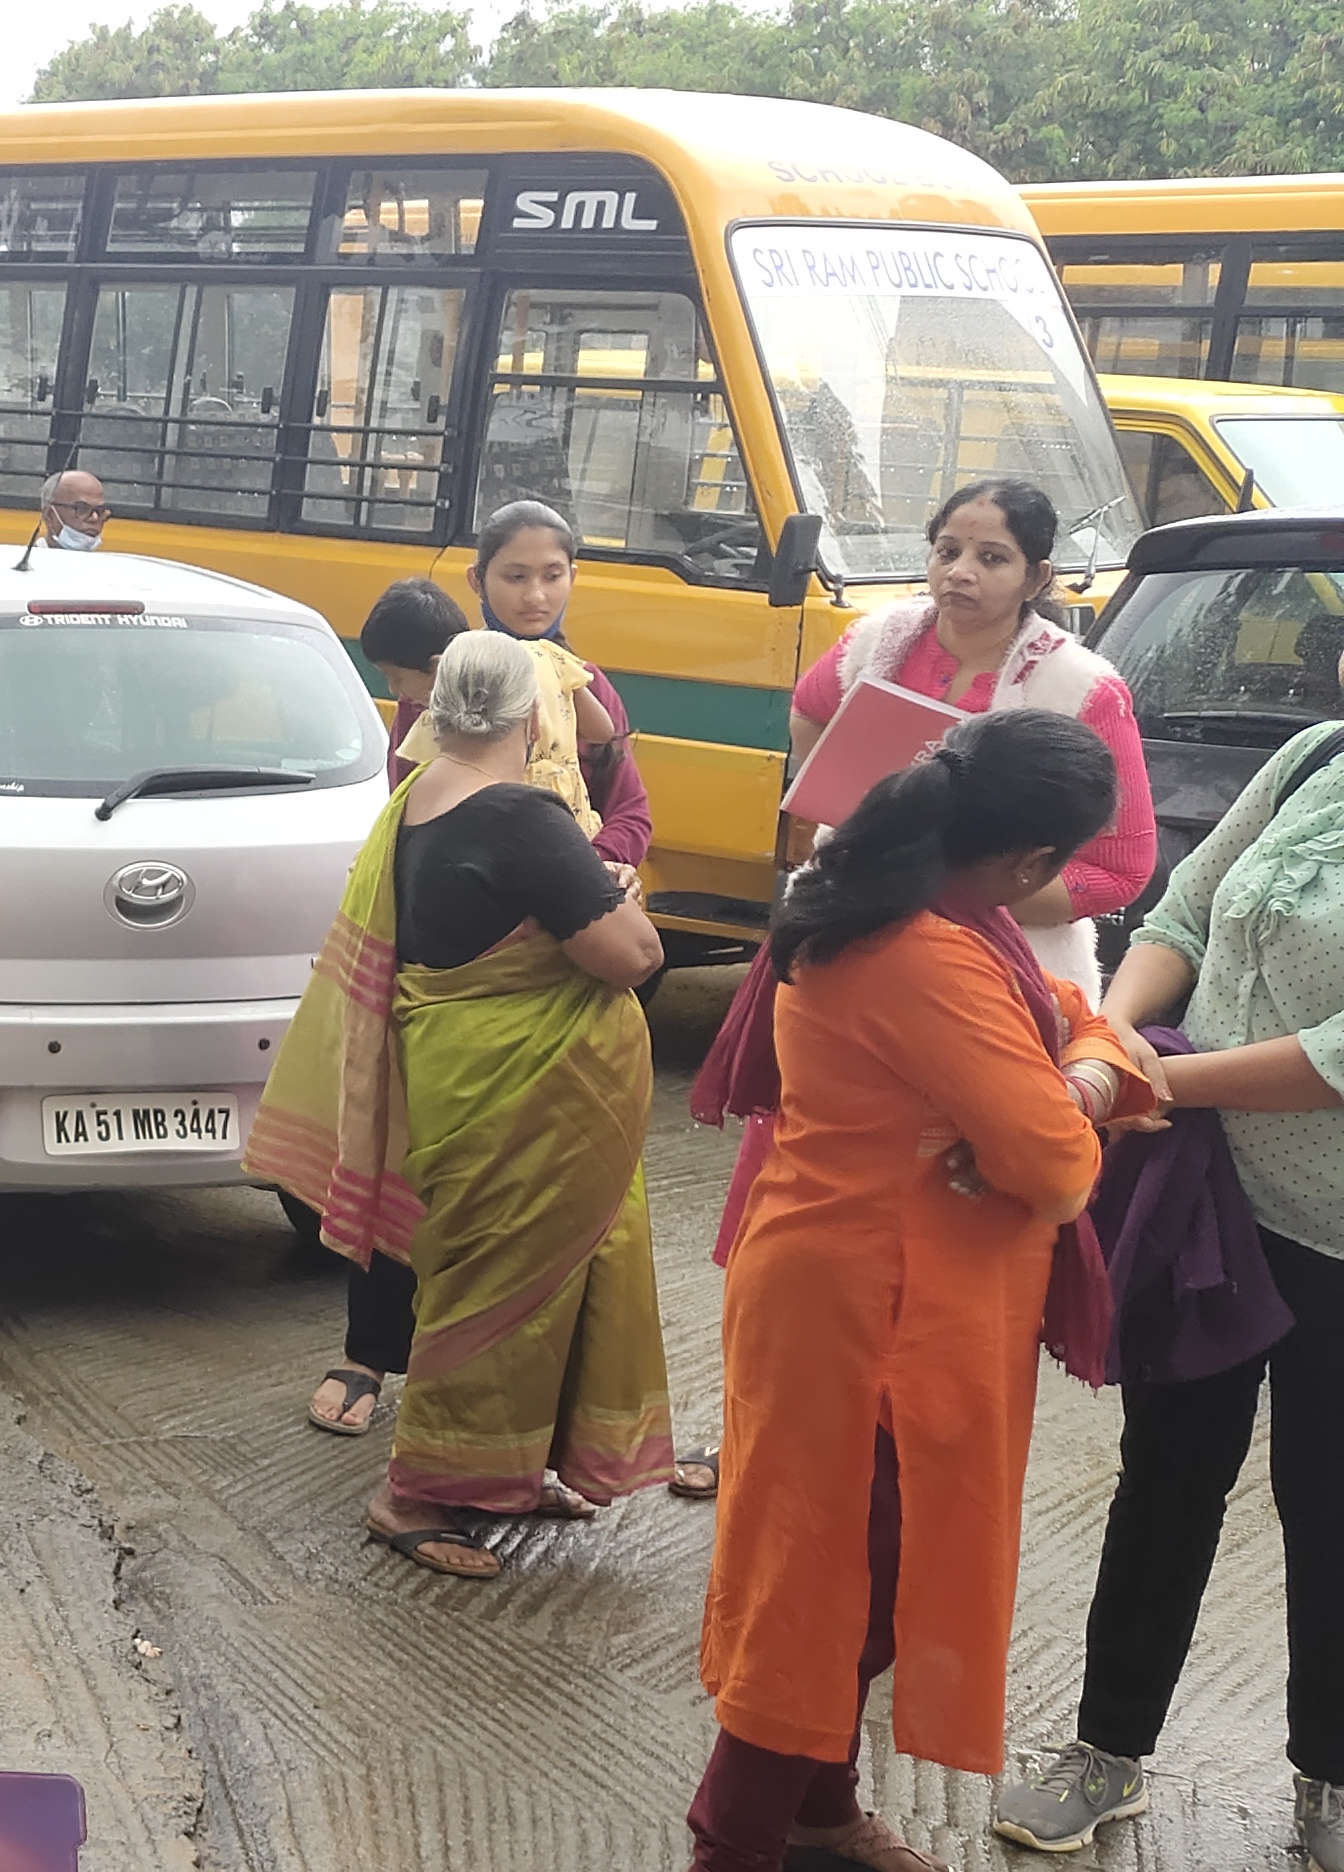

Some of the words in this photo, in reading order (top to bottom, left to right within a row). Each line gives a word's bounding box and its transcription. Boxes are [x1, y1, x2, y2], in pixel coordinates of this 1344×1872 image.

[513, 190, 658, 231] SML
[752, 248, 800, 288] SRI
[802, 249, 866, 288] RAM
[866, 250, 955, 290] PUBLIC
[954, 252, 1047, 295] SCHO
[1035, 315, 1054, 348] 3
[42, 614, 111, 625] TRIDENT
[117, 615, 188, 628] HYUNDAI
[55, 1110, 89, 1143] KA
[95, 1109, 124, 1142] 51
[132, 1108, 169, 1140] MB
[173, 1107, 230, 1140] 3447
